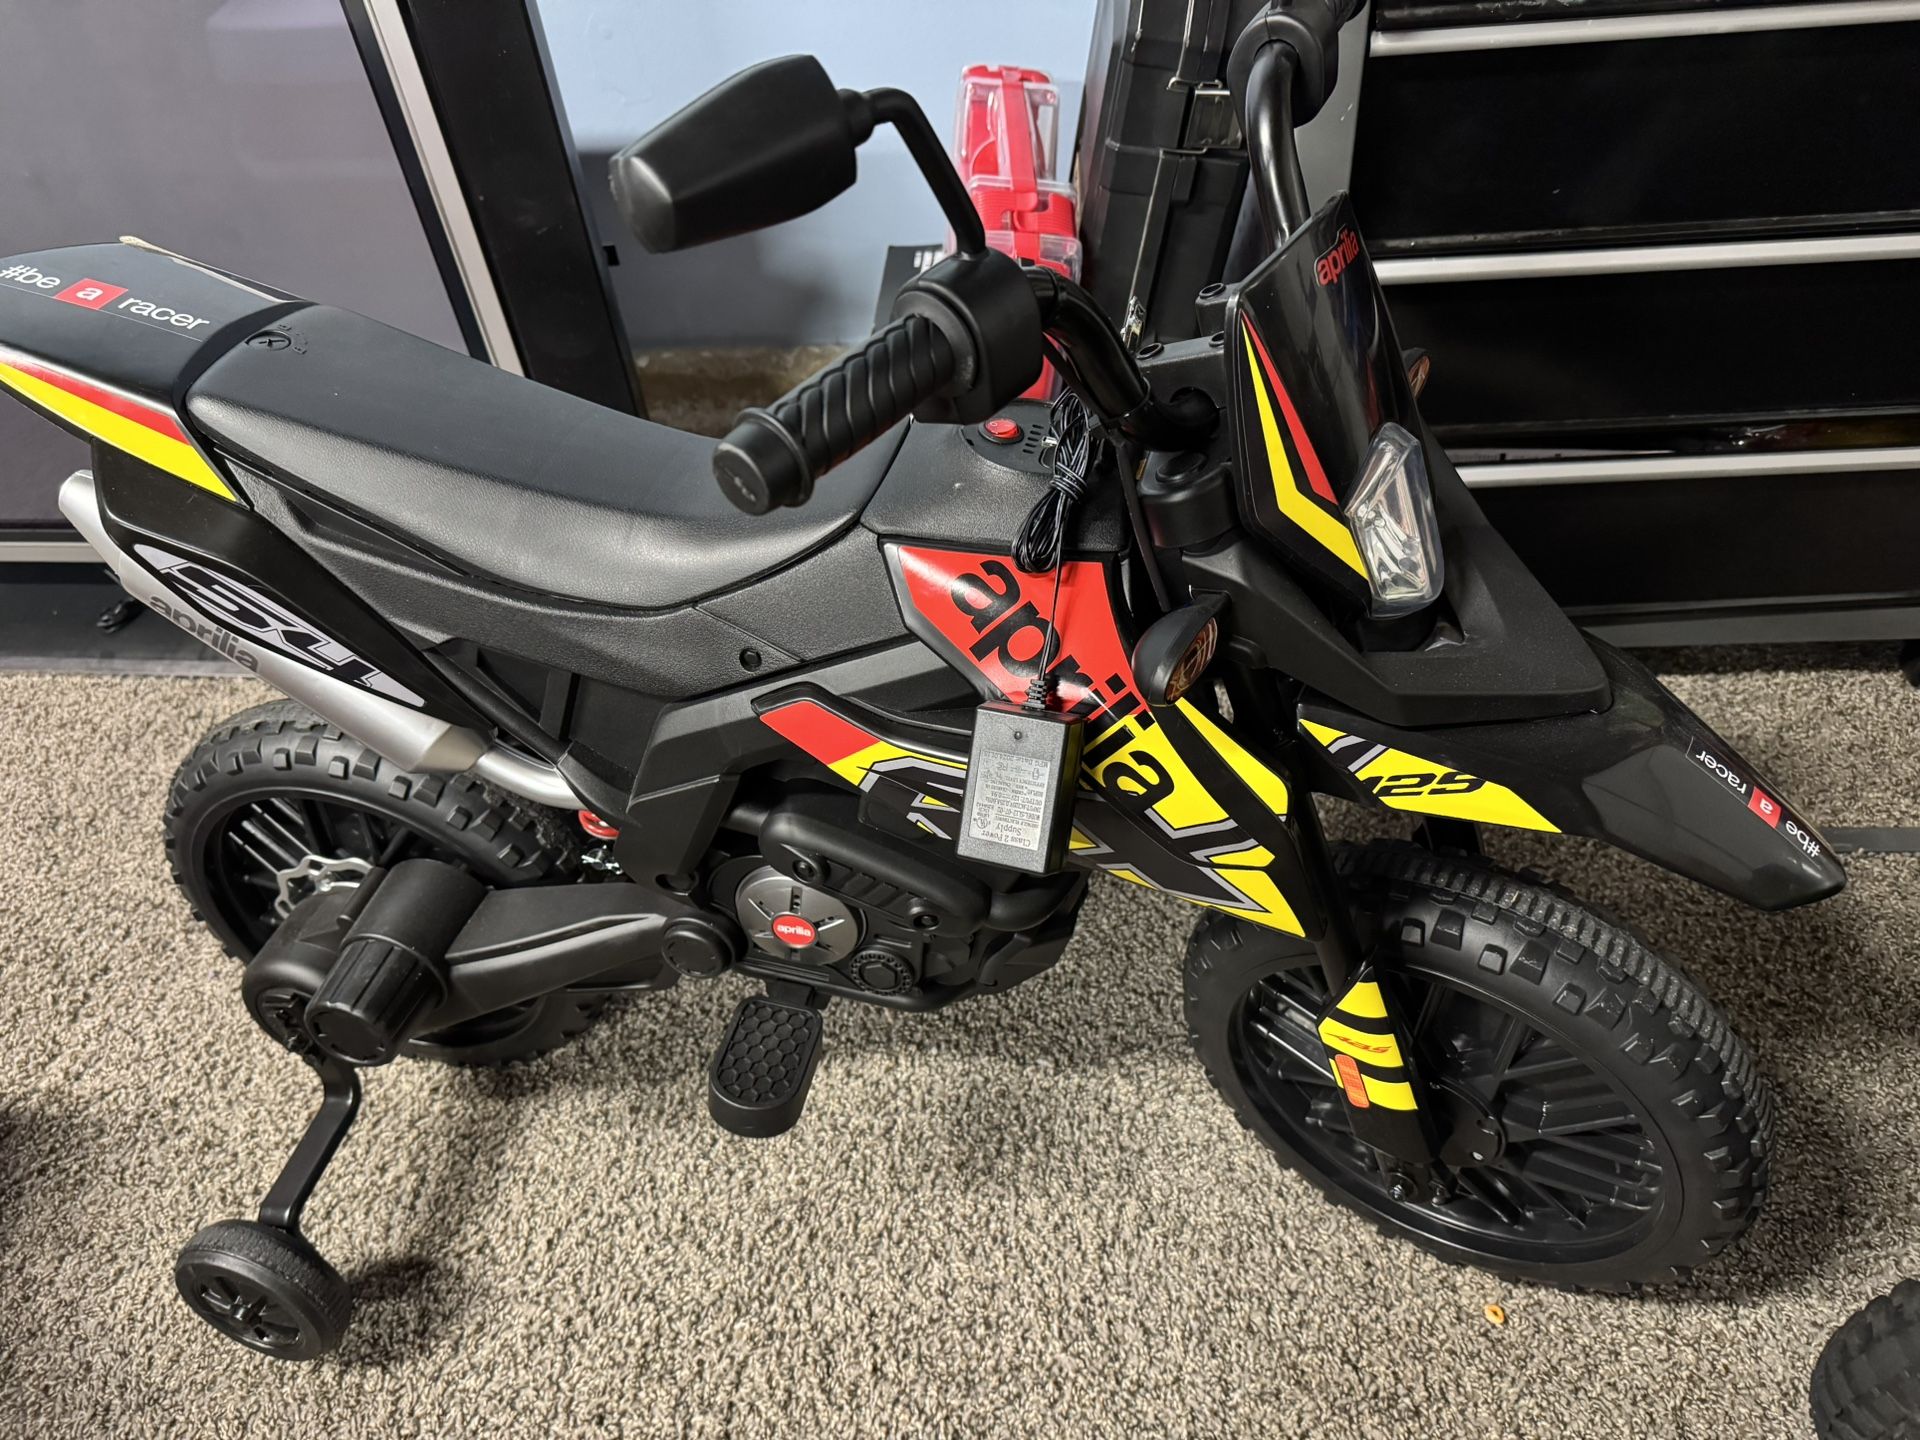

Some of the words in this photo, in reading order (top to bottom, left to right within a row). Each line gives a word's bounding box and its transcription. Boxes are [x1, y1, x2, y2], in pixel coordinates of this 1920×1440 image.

[1316, 228, 1360, 286] aprilia
[0, 264, 61, 289] #be
[75, 287, 104, 301] a
[117, 297, 210, 330] racer
[149, 595, 259, 673] aprilia
[950, 559, 1175, 809] aprilia
[1360, 771, 1486, 798] 125
[1695, 750, 1747, 794] racer
[1759, 797, 1774, 815] a
[980, 829, 1003, 842] Power
[994, 821, 1022, 837] Supply
[1003, 834, 1010, 844] 2
[1009, 835, 1031, 848] Class
[1785, 820, 1821, 858] #be
[776, 924, 812, 937] aprilia
